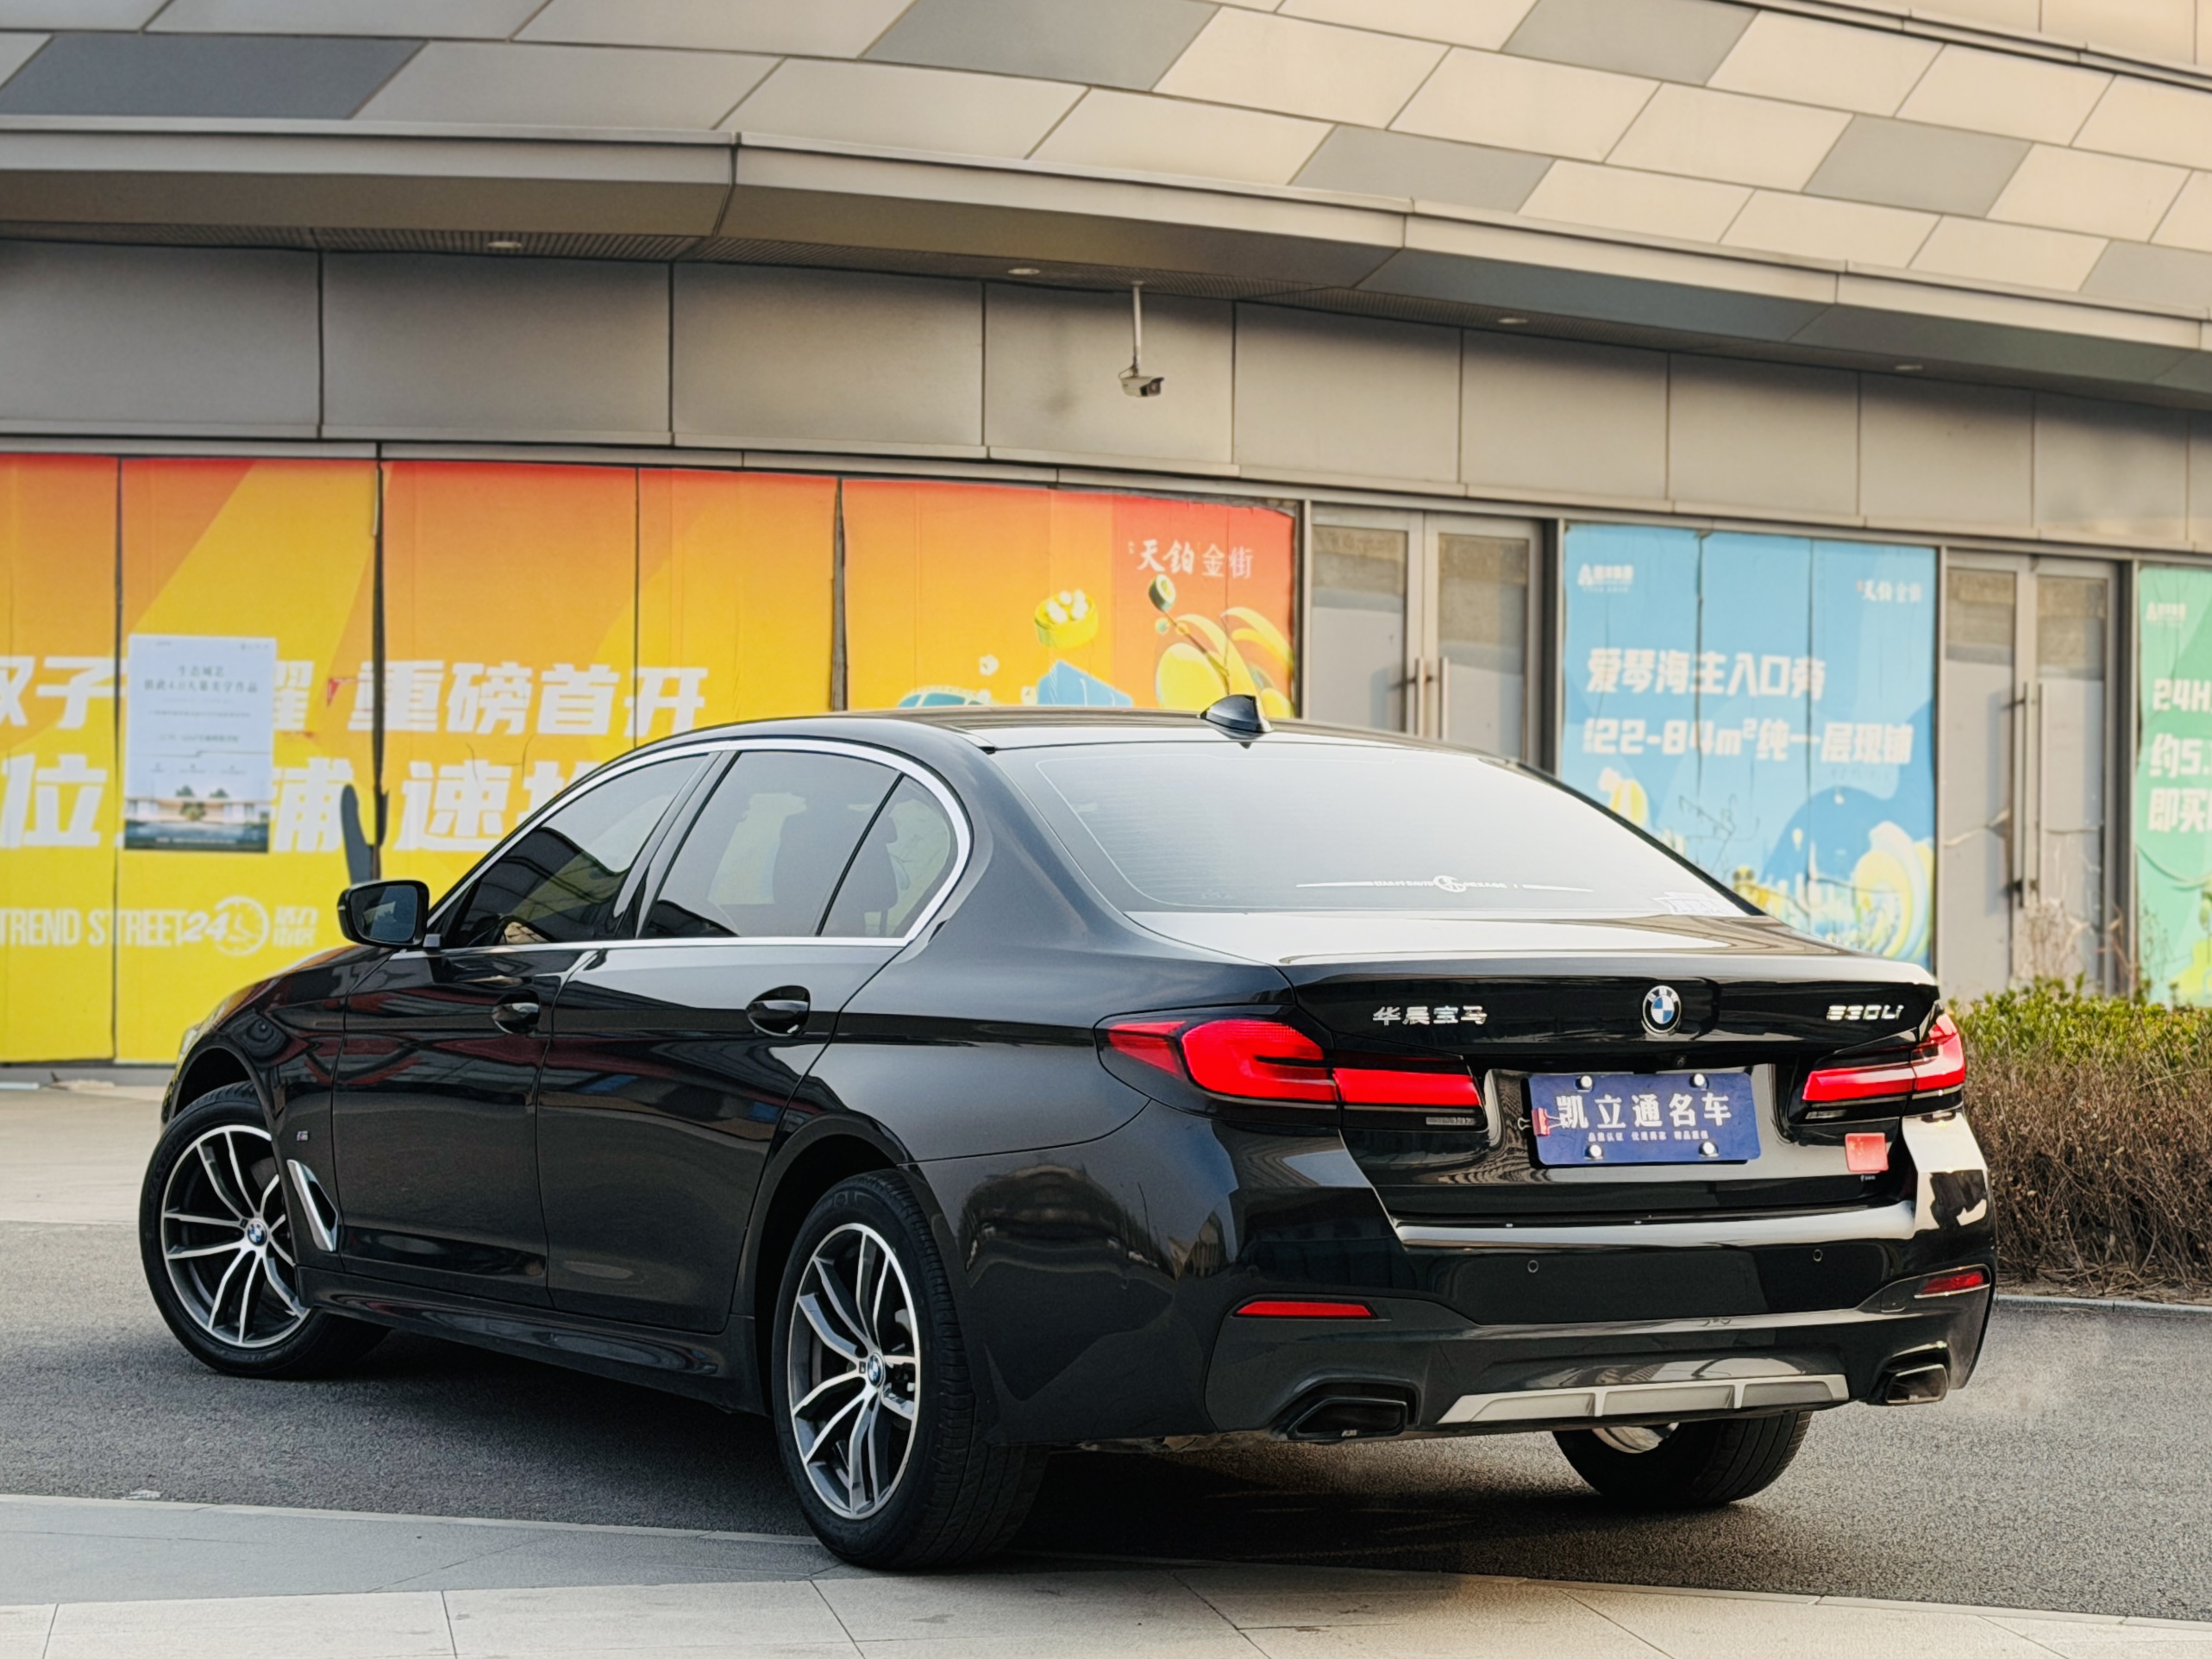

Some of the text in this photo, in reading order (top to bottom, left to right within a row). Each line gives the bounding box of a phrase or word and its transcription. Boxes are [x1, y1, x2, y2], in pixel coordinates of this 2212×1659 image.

[348, 660, 709, 736] 重磅首开
[1587, 648, 1826, 701] 爱琴海主入口旁
[2152, 679, 2212, 711] 24H
[2148, 732, 2212, 779] 约5.
[2147, 786, 2212, 833] 即买
[1372, 1005, 1488, 1026] 华晨宝马
[1556, 1092, 1732, 1130] 凯立通名车
